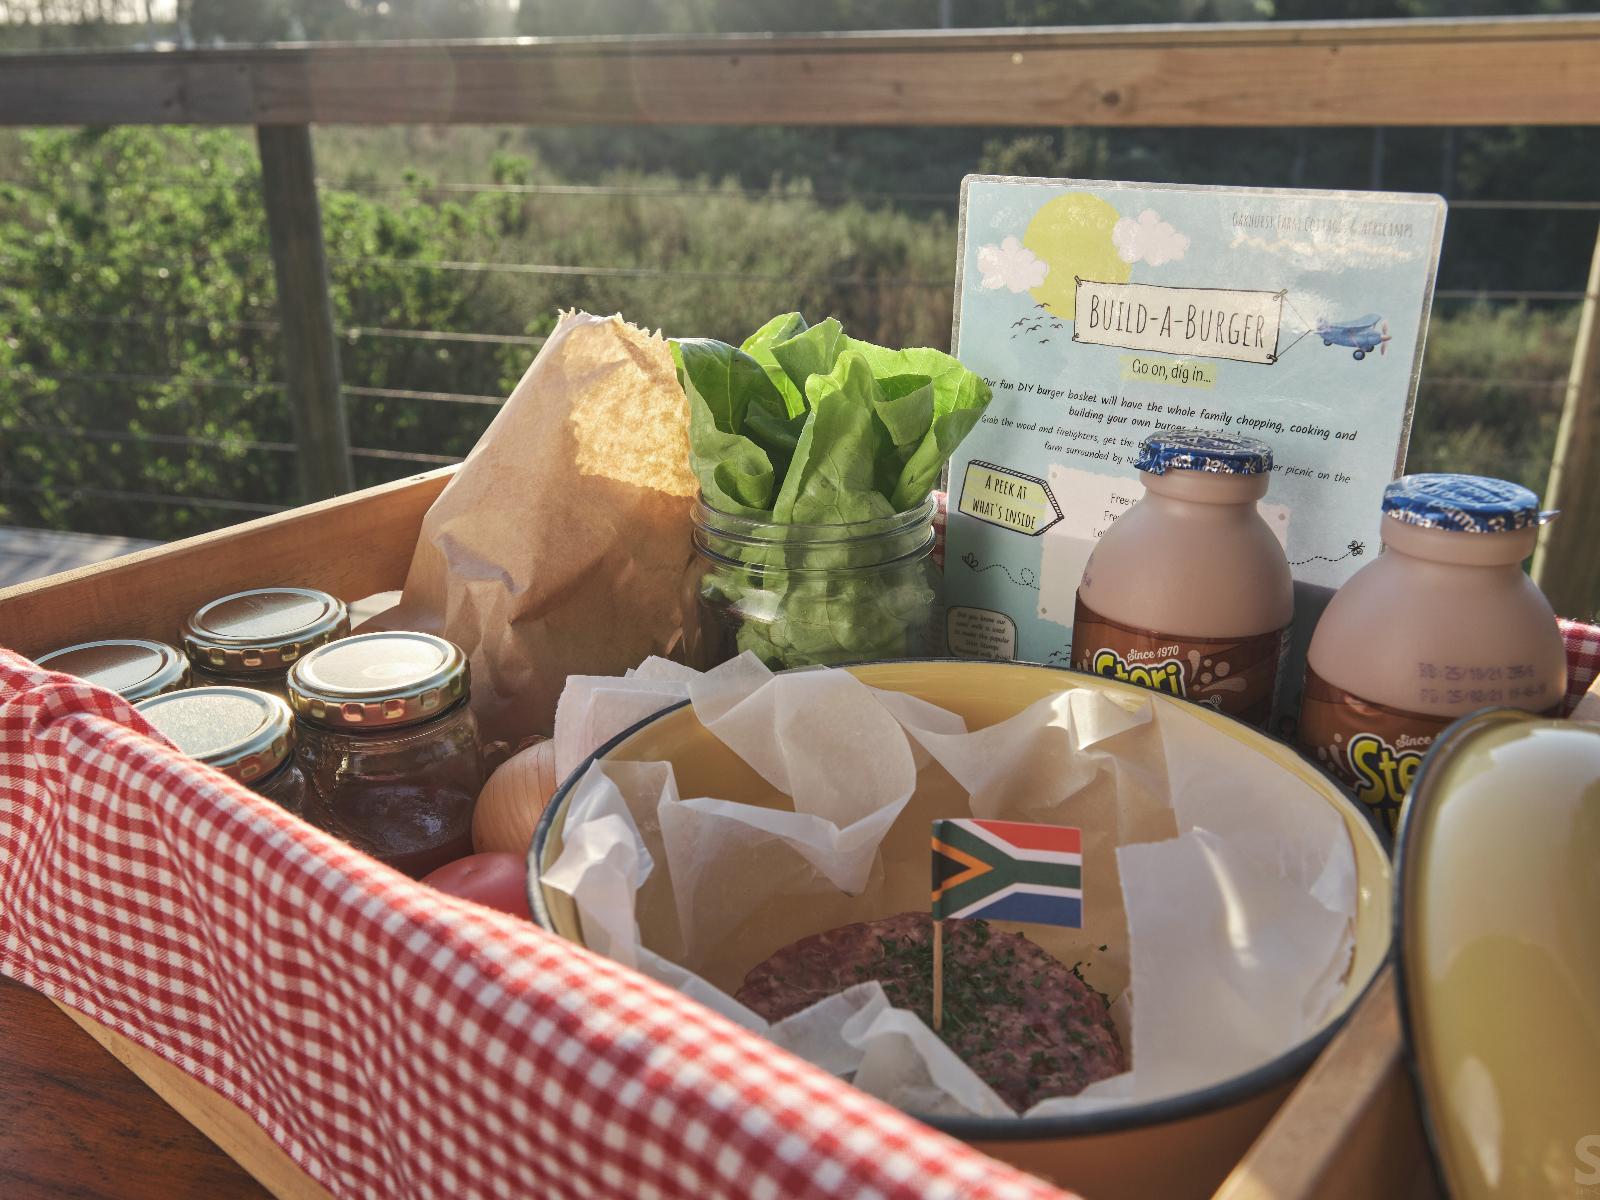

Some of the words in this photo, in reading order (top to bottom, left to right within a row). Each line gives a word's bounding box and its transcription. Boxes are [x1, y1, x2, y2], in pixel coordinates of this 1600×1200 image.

[1089, 294, 1265, 348] BUILD-A-BURGER
[1132, 358, 1148, 375] Go
[1151, 363, 1168, 381] on,
[1171, 364, 1189, 383] dig
[1192, 365, 1211, 383] in...
[982, 378, 996, 388] Our
[999, 379, 1014, 390] fun
[1018, 382, 1034, 393] DIY
[1037, 385, 1064, 399] burger
[1068, 389, 1097, 403] basket
[1101, 395, 1116, 406] will
[1121, 398, 1143, 410] have
[1147, 402, 1163, 412] the
[1167, 404, 1195, 417] whole
[1200, 409, 1232, 425] family
[1237, 415, 1285, 433] chopping,
[1290, 424, 1330, 440] cooking
[1335, 431, 1357, 441] and
[1069, 406, 1103, 423] building
[1107, 415, 1127, 425] your
[1131, 418, 1151, 427] own
[982, 415, 999, 425] Grab
[1001, 417, 1014, 427] the
[1016, 421, 1036, 431] wood
[1039, 425, 1053, 434] and
[1056, 426, 1100, 444] firelighters,
[1103, 437, 1116, 448] get
[1120, 437, 1134, 448] the
[1044, 440, 1062, 452] farm
[1066, 446, 1109, 461] surrounded
[1112, 453, 1123, 464] by
[985, 474, 992, 489] A
[994, 478, 1013, 494] PEEK
[1016, 486, 1028, 499] AT
[1285, 465, 1314, 478] picnic
[1318, 471, 1330, 480] on
[1334, 472, 1351, 483] the
[972, 498, 1002, 520] WHAT'S
[1006, 508, 1036, 530] INSIDE
[1127, 648, 1155, 663] Since
[1156, 645, 1179, 658] 1970
[1396, 734, 1432, 749] Since
[1353, 740, 1422, 804] Ste
